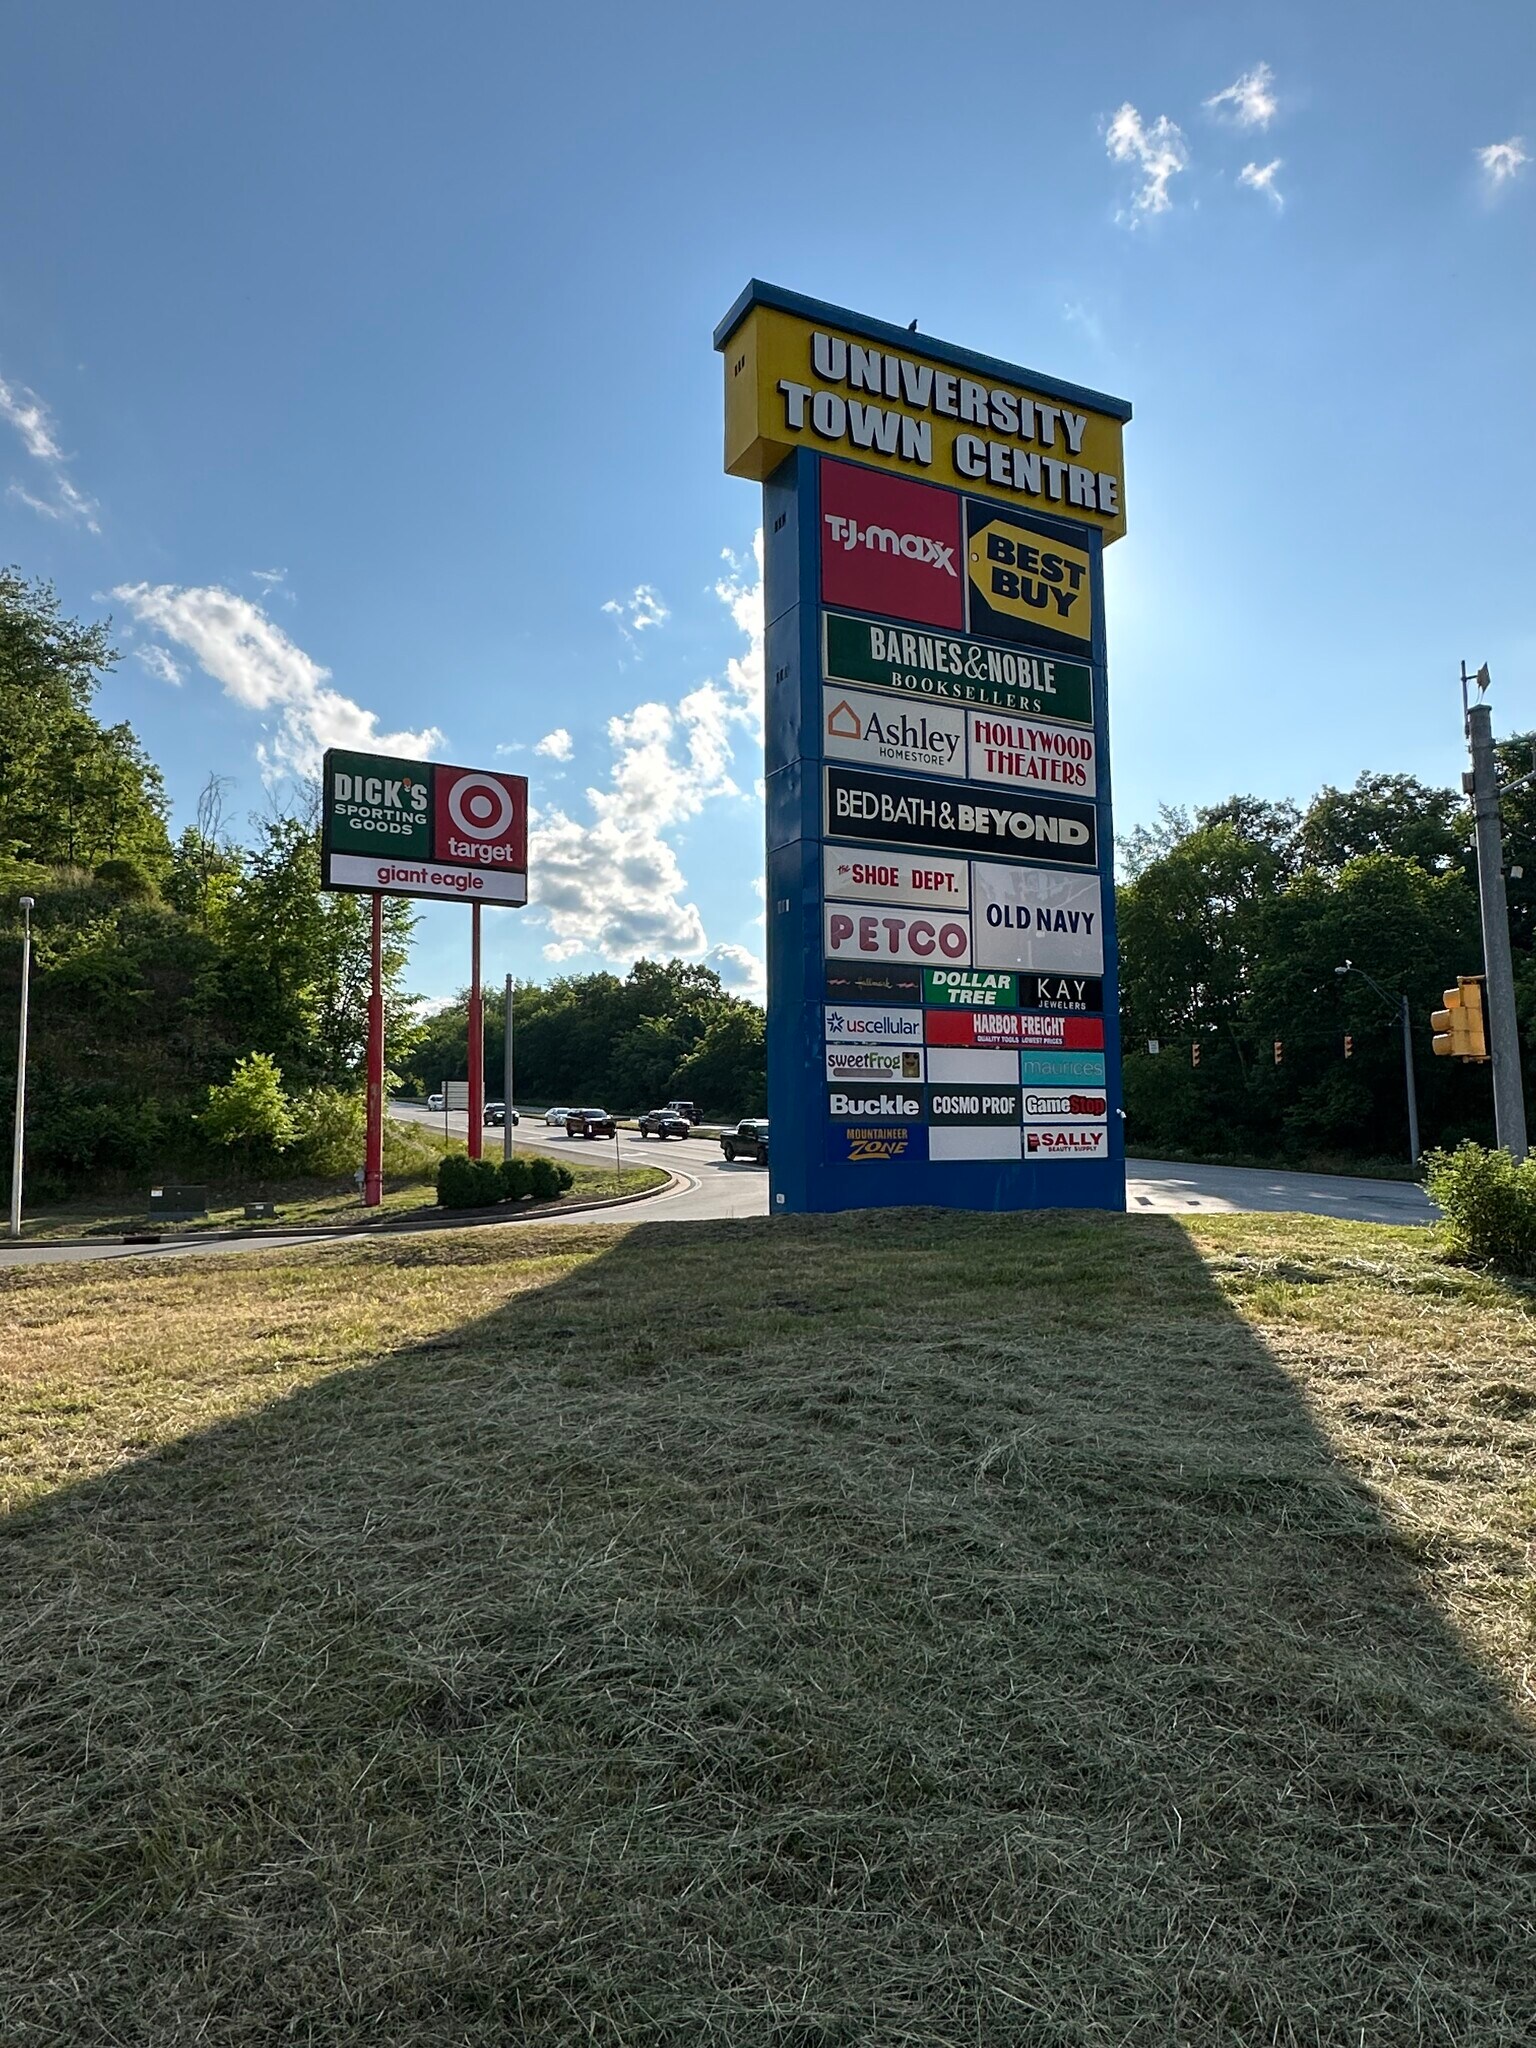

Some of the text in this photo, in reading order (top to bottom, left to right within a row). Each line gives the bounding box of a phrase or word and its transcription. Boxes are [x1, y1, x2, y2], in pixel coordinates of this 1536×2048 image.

[812, 331, 1087, 454] UNIVERSITY
[778, 379, 1118, 516] TOWN CENTRE
[987, 532, 1086, 590] BEST
[991, 566, 1078, 618] BUY
[891, 671, 1042, 712] BOOKSELLERS
[863, 712, 960, 762] Ashley
[975, 720, 1092, 761] HOLLYWOOD
[880, 746, 944, 766] HOMESTORE
[984, 748, 1086, 786] THEATERS
[334, 773, 428, 811] DICK'S
[334, 803, 427, 824] SPORTING
[836, 788, 879, 819] BED
[881, 794, 936, 827] BATH
[958, 804, 1090, 846] BEYOND
[349, 818, 413, 835] GOODS
[448, 837, 513, 864] target
[377, 865, 484, 892] giant eagle
[852, 863, 899, 887] SHOE
[912, 869, 959, 893] DEPT.
[987, 903, 1095, 935] OLD NAVY
[830, 914, 967, 958] PETCO
[932, 971, 1011, 989] DOLLAR
[1037, 978, 1085, 1000] KAY
[948, 989, 997, 1005] TREE
[1038, 1000, 1086, 1010] JEWELERS
[973, 1014, 1065, 1036] HARBOR FREIGHT
[828, 1052, 900, 1069] sweetFrog
[1024, 1060, 1103, 1076] maurices
[830, 1094, 919, 1115] Buckle
[932, 1096, 1016, 1114] COSMO PROF
[1026, 1095, 1106, 1116] GameStop
[847, 1128, 908, 1140] MOUNTAINEER
[1042, 1133, 1103, 1146] SALLY
[848, 1140, 908, 1160] ZONE
